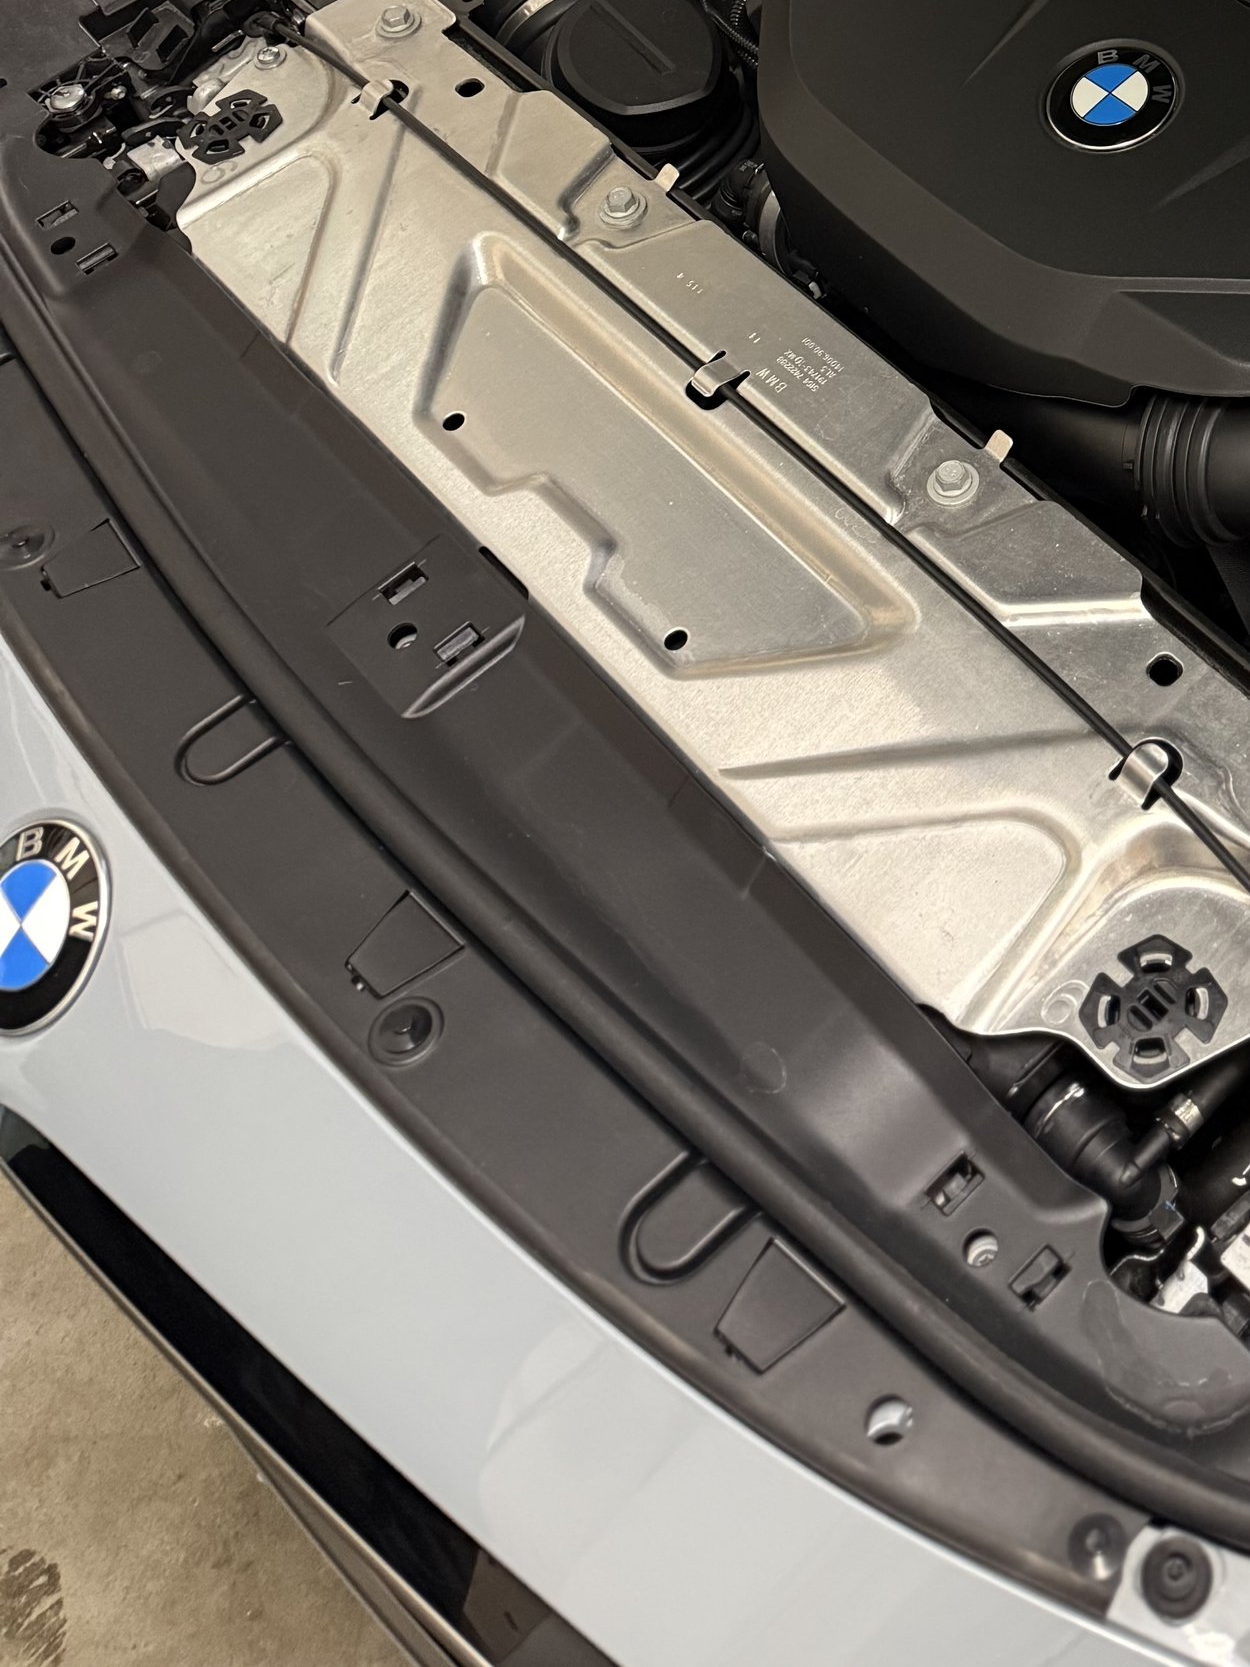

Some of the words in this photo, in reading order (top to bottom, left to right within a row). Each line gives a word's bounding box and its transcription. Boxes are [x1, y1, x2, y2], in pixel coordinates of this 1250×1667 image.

[1097, 49, 1172, 104] BMW
[756, 367, 788, 394] BMW
[16, 827, 99, 943] BMW
